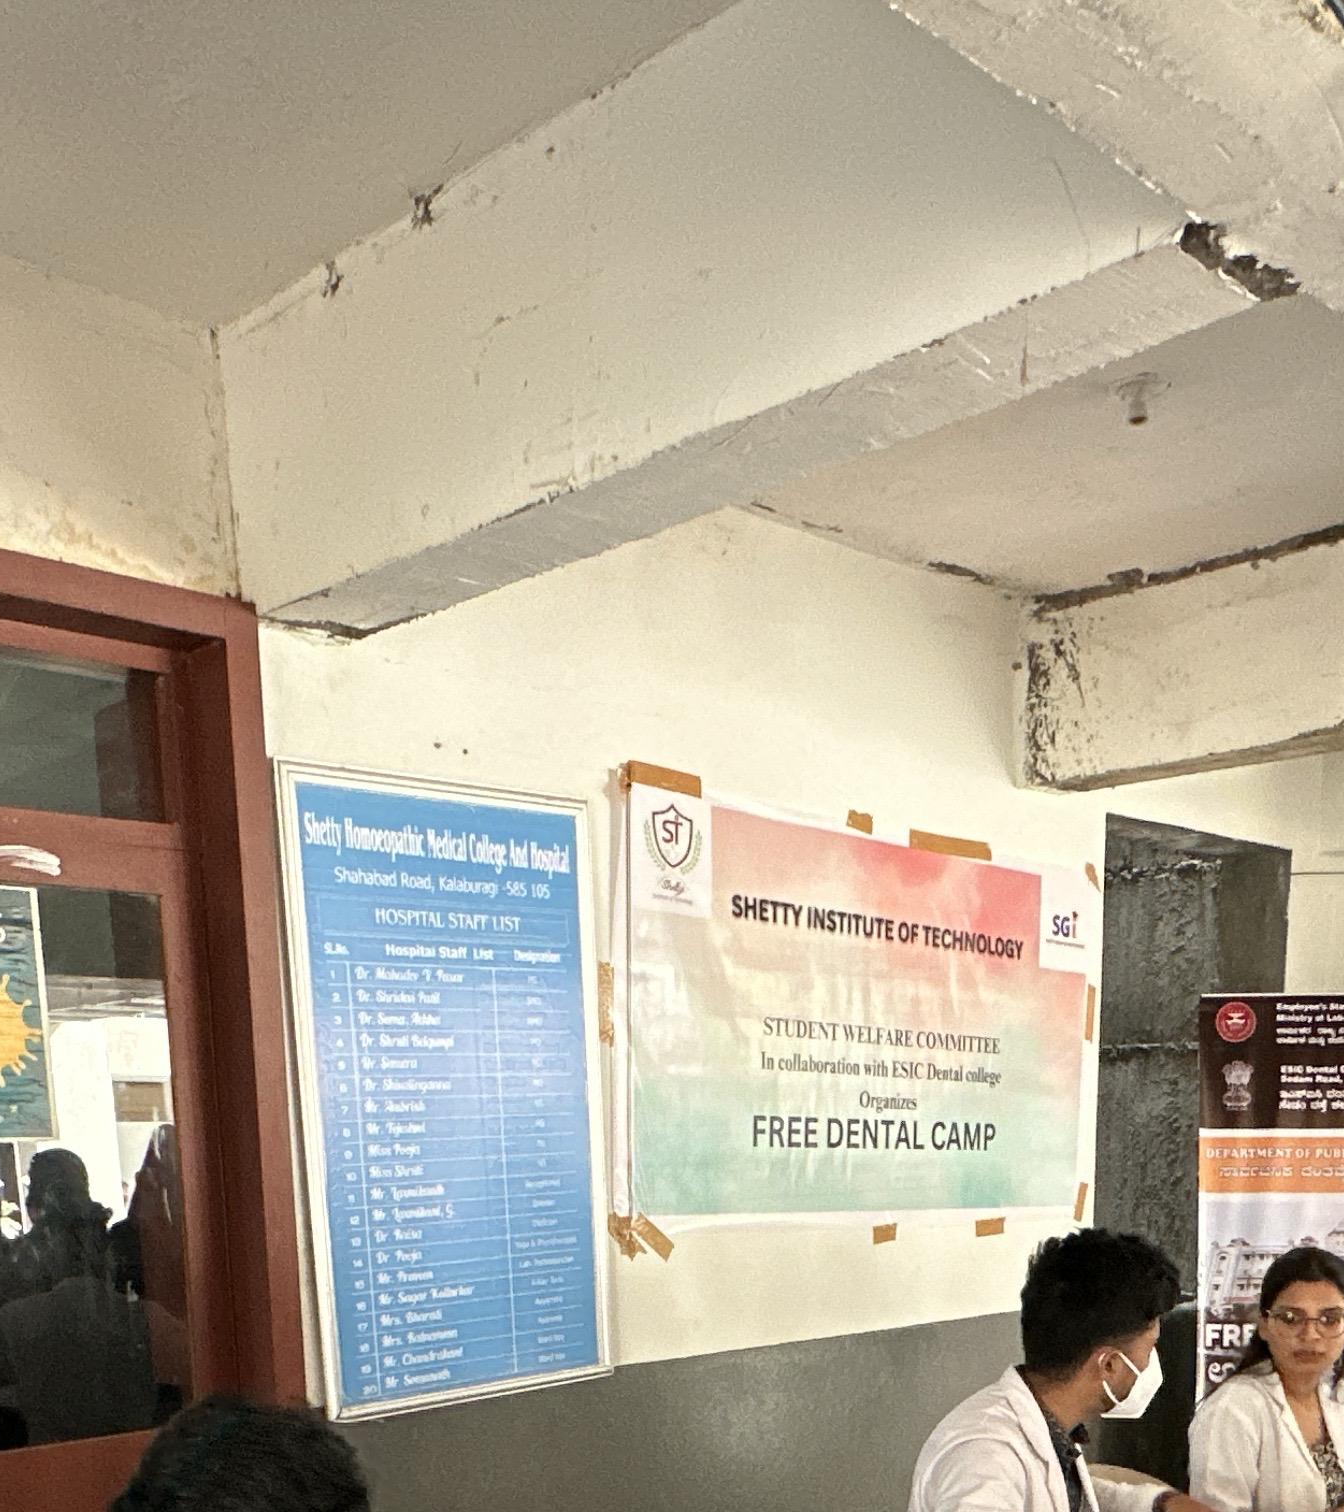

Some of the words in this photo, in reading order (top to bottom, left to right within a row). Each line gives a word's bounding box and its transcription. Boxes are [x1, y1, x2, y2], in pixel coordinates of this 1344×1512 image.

[304, 812, 341, 856] Shetty
[345, 818, 424, 862] Homoeopathic
[427, 829, 466, 861] Medical
[469, 833, 507, 875] College
[509, 840, 527, 868] And
[530, 842, 570, 879] Hospital
[334, 866, 397, 887] Shahabad
[400, 872, 435, 892] Road,
[375, 908, 444, 928] HOSPITAL
[448, 913, 488, 931] STAFF
[493, 916, 520, 932] LIST
[731, 895, 803, 926] SHETTY
[807, 906, 894, 941] INSTITUTE
[898, 922, 919, 943] OF
[922, 925, 1024, 960] TECHNOLOGY
[763, 1017, 839, 1041] STUDENT
[843, 1024, 913, 1047] WELFARE
[916, 1032, 1001, 1054] COMMITTEE
[761, 1051, 774, 1070] In
[778, 1054, 860, 1075] collaboration
[864, 1060, 888, 1078] with
[892, 1061, 924, 1079] ESIC
[927, 1063, 962, 1082] Dental
[965, 1067, 1001, 1088] college
[859, 1091, 917, 1113] Organizes
[753, 1115, 818, 1148] FREE
[827, 1118, 924, 1150] DENTAL
[931, 1122, 996, 1151] CAMP
[1206, 1149, 1292, 1158] DEPARTMENT
[1296, 1149, 1312, 1158] OF
